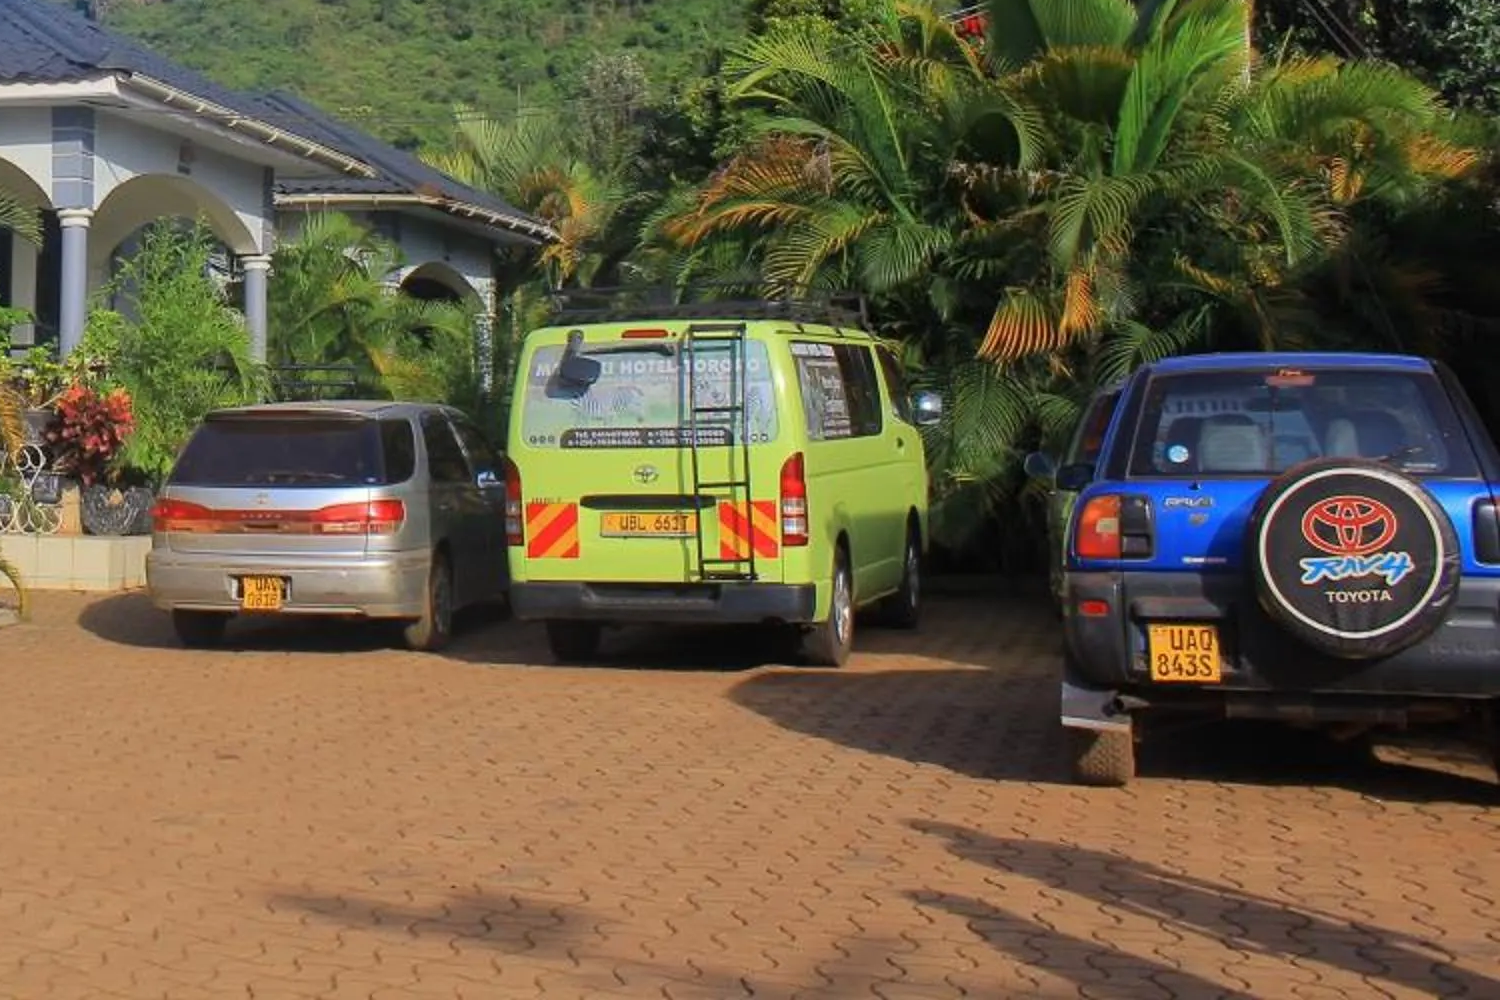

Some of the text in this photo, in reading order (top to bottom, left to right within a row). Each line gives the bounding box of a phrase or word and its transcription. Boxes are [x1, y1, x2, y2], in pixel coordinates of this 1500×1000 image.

[620, 359, 678, 374] HOTEL
[1299, 552, 1414, 585] RAV4
[1325, 589, 1393, 604] TOYOTA
[1169, 628, 1213, 651] UAQ
[1157, 653, 1213, 677] 843S
